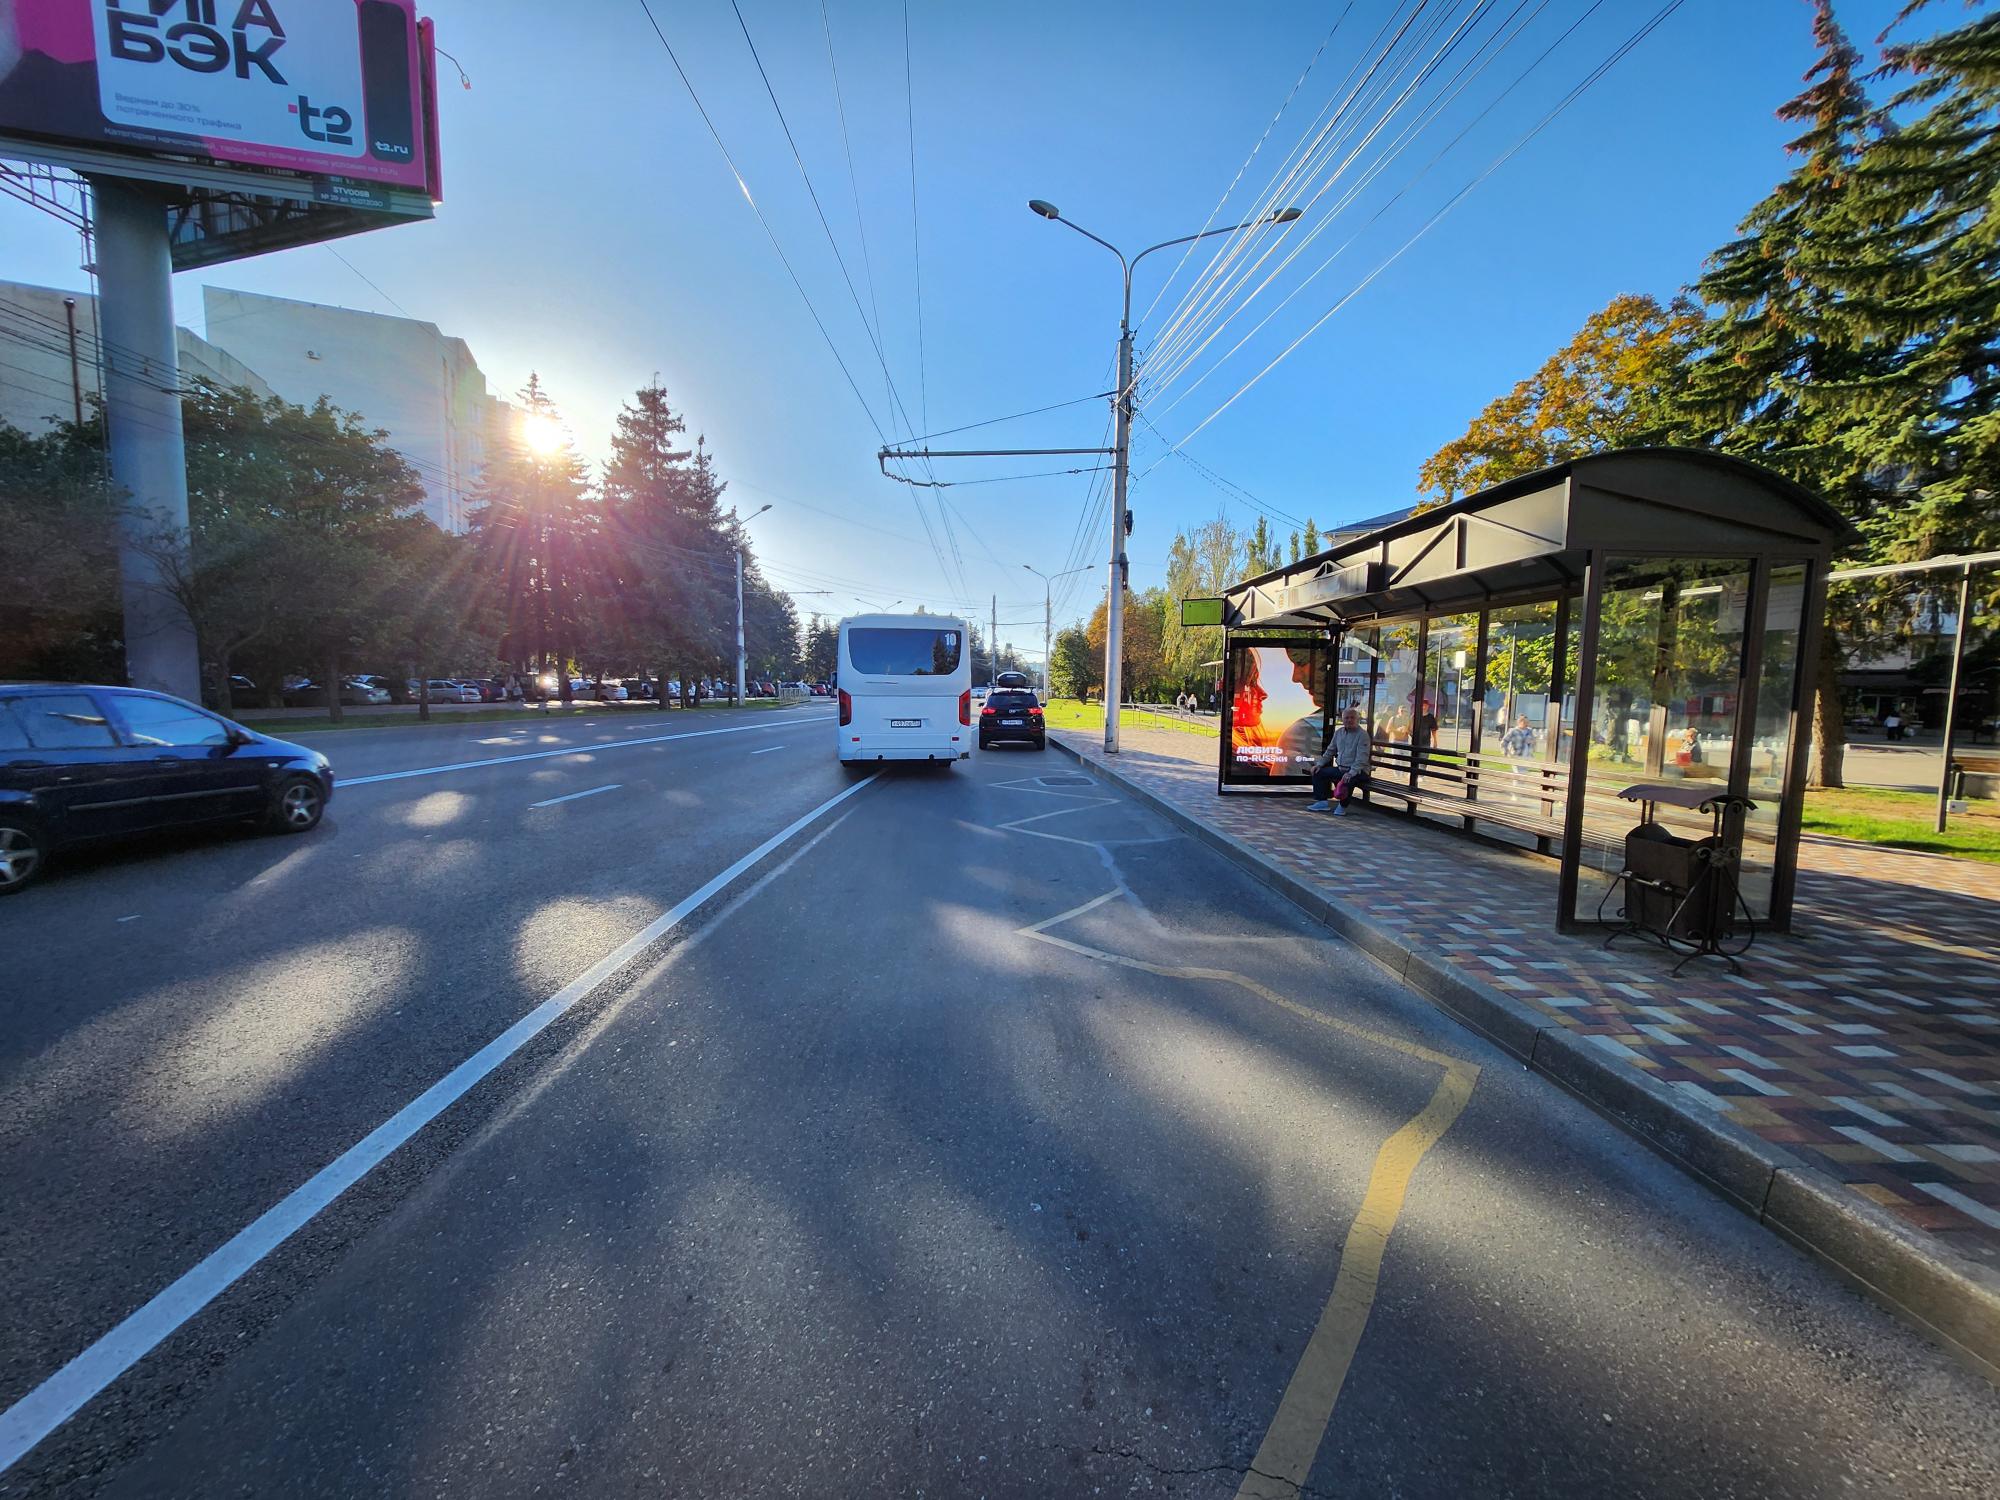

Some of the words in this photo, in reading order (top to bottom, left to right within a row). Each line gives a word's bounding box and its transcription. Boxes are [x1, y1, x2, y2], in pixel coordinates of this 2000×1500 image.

[106, 8, 289, 86] БЭК
[298, 95, 353, 145] t2
[375, 141, 409, 154] t2.ru
[945, 633, 957, 646] 10
[1236, 746, 1283, 754] ЛЮБИТЬ
